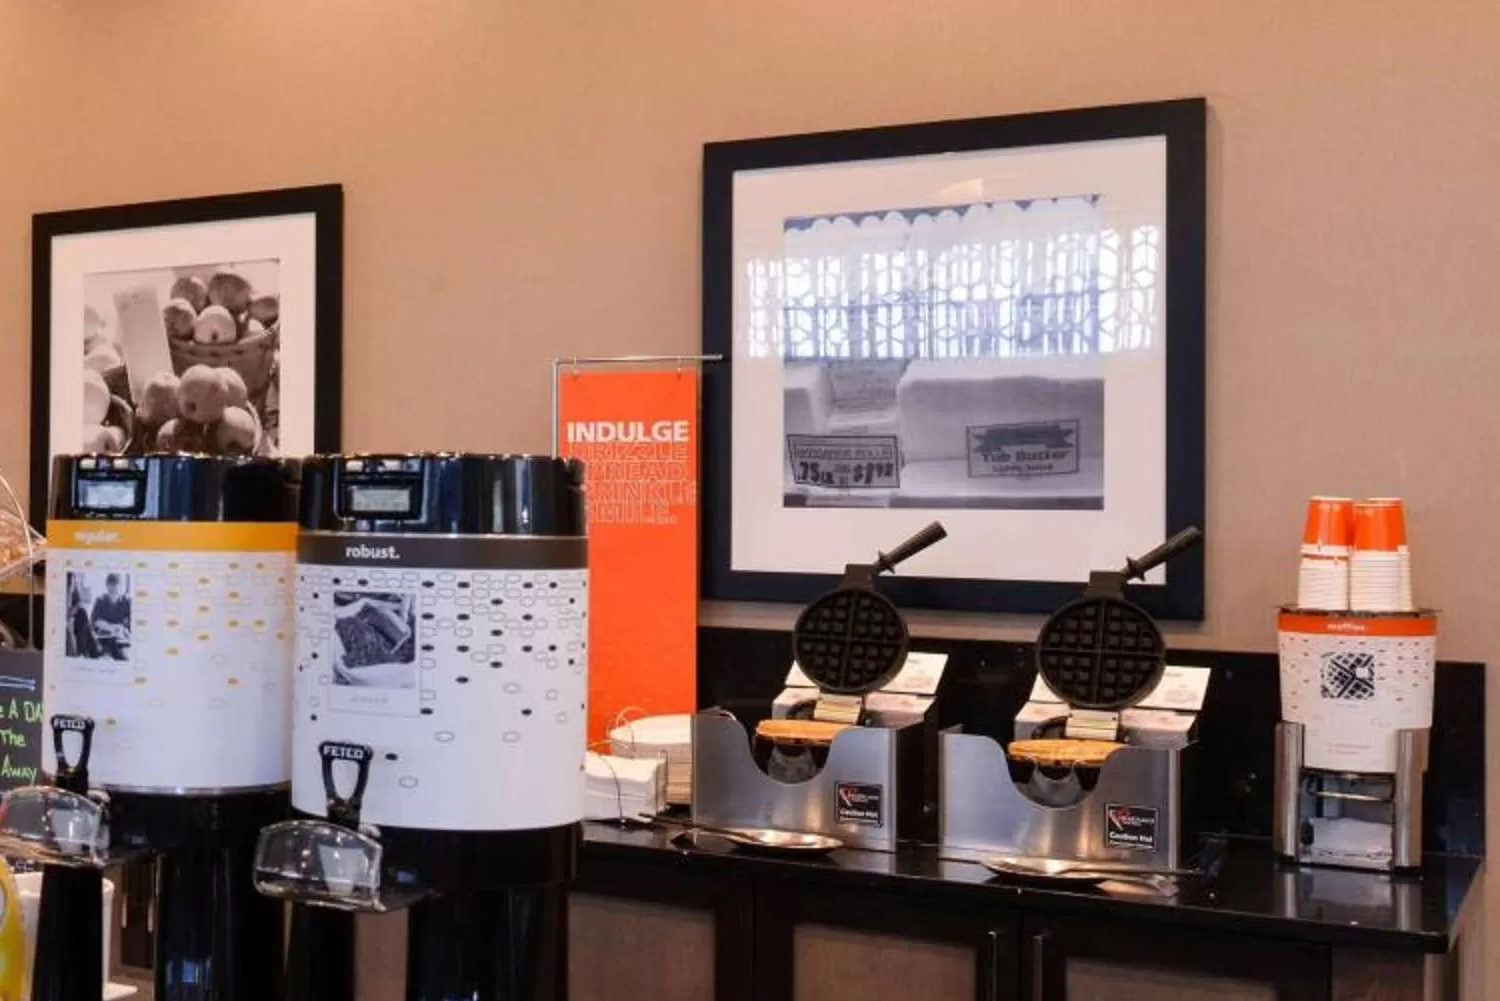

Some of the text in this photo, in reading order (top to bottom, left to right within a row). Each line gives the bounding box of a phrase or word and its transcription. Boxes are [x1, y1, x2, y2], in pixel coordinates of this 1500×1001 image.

[567, 420, 690, 443] INDULGE
[345, 544, 401, 559] robust.
[8, 696, 19, 720] A
[323, 745, 365, 760] FETCO
[1110, 831, 1153, 843] Caution Hot
